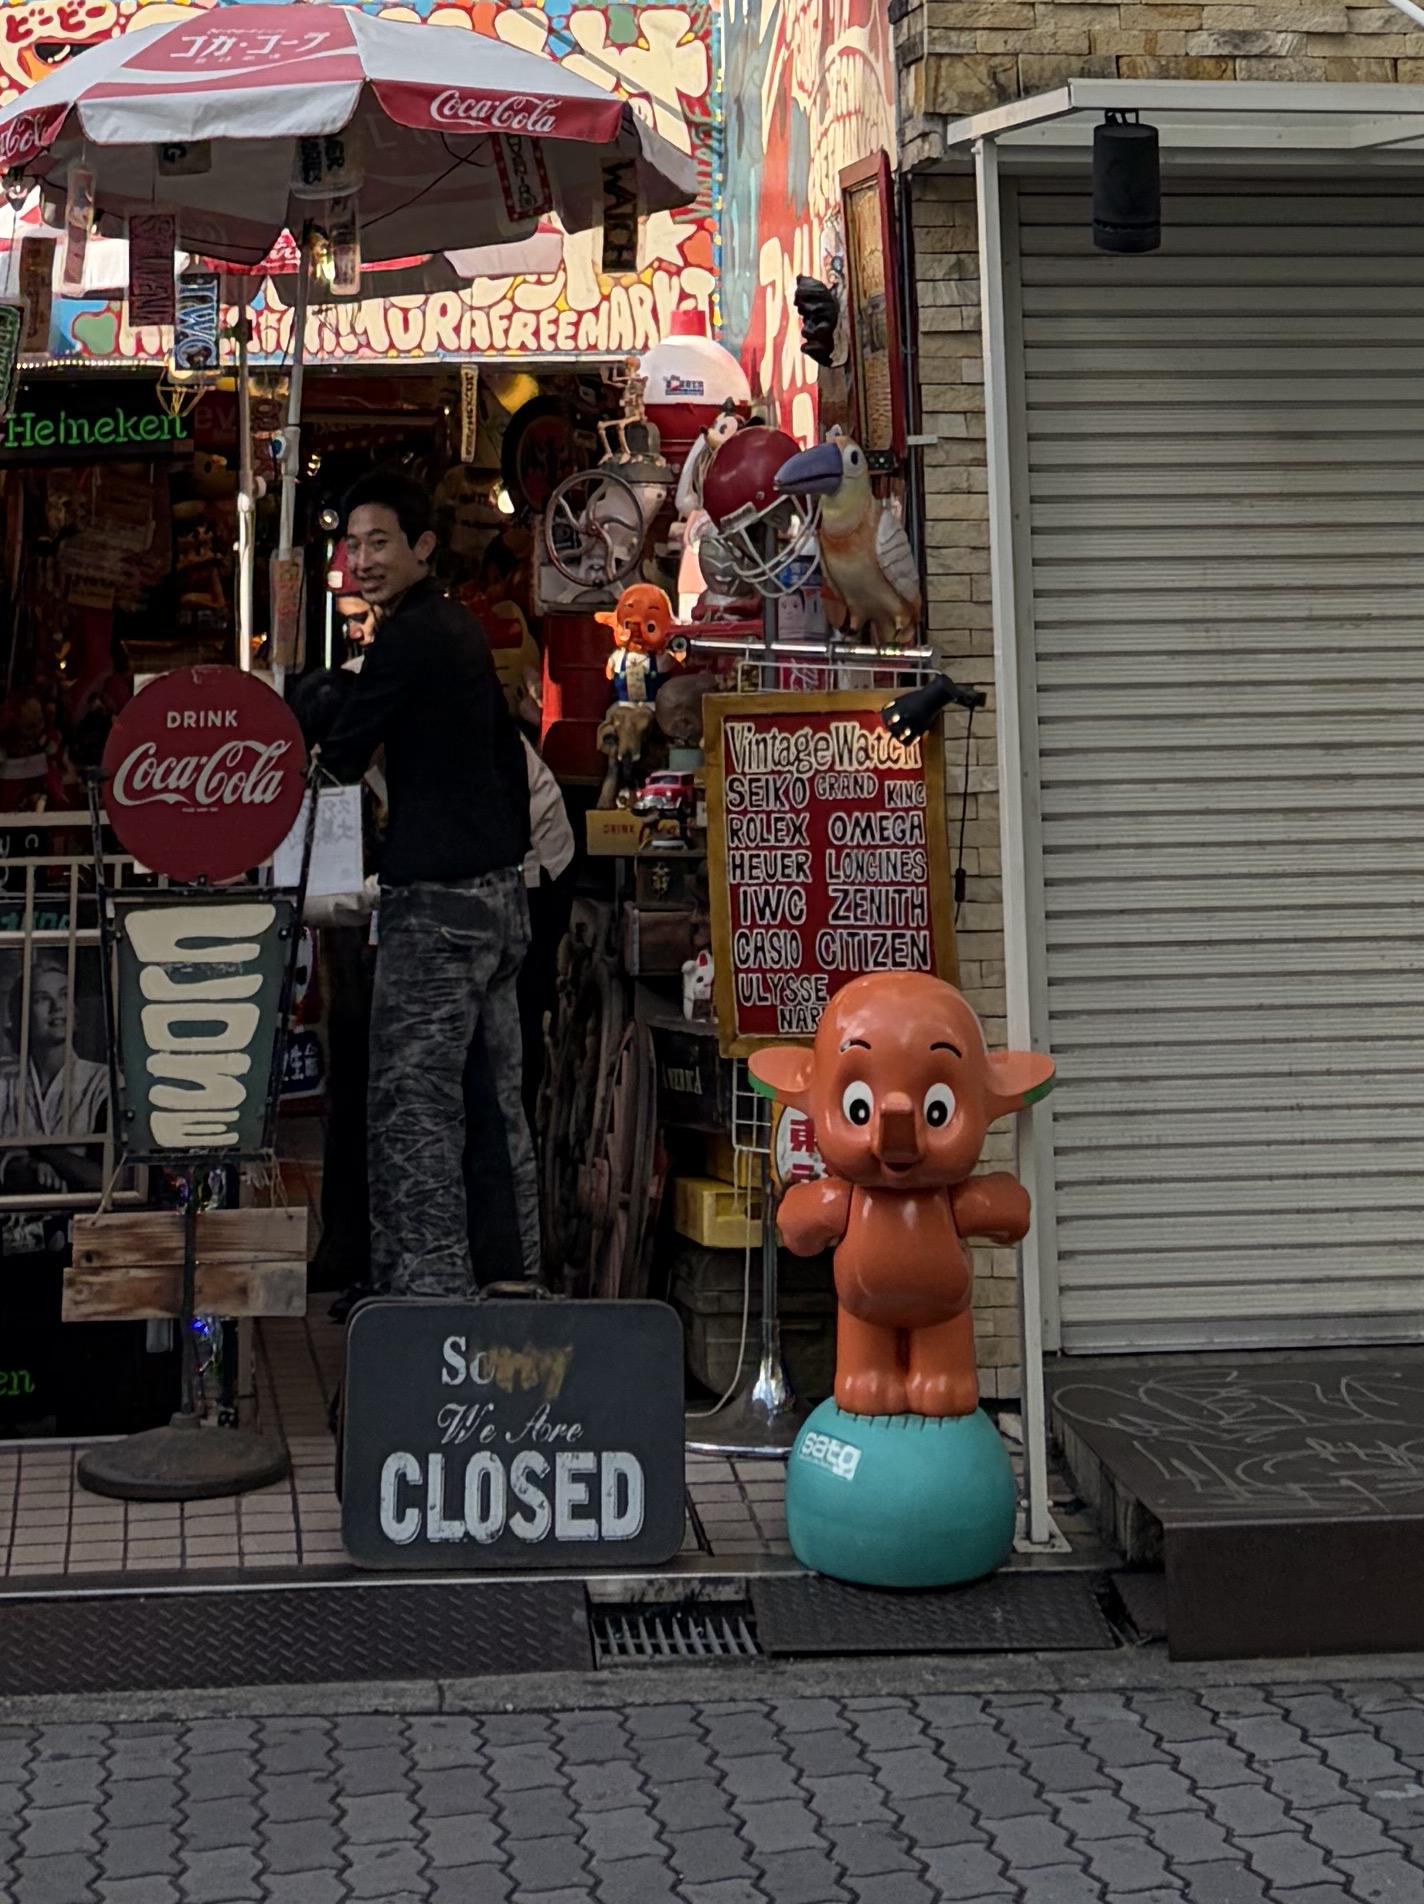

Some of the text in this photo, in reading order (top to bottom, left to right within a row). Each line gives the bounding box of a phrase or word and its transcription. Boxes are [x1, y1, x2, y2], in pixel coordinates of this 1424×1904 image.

[429, 88, 562, 134] Coca-Cola
[4, 407, 189, 451] Heineken
[166, 709, 239, 728] DRINK
[726, 721, 832, 777] Vintage
[112, 739, 292, 806] Coca-Cola
[727, 772, 927, 811] SEIKO GRAND KING
[728, 811, 926, 848] ROLEX OMEGA
[729, 848, 927, 884] HEUER LONGINES
[739, 885, 928, 927] IWC ZENITH
[734, 928, 932, 971] CASIO CITIZEN
[737, 972, 831, 1007] ULYSSE
[777, 1005, 825, 1033] NAR
[437, 1402, 584, 1445] We Are
[379, 1449, 645, 1546] CLOSED
